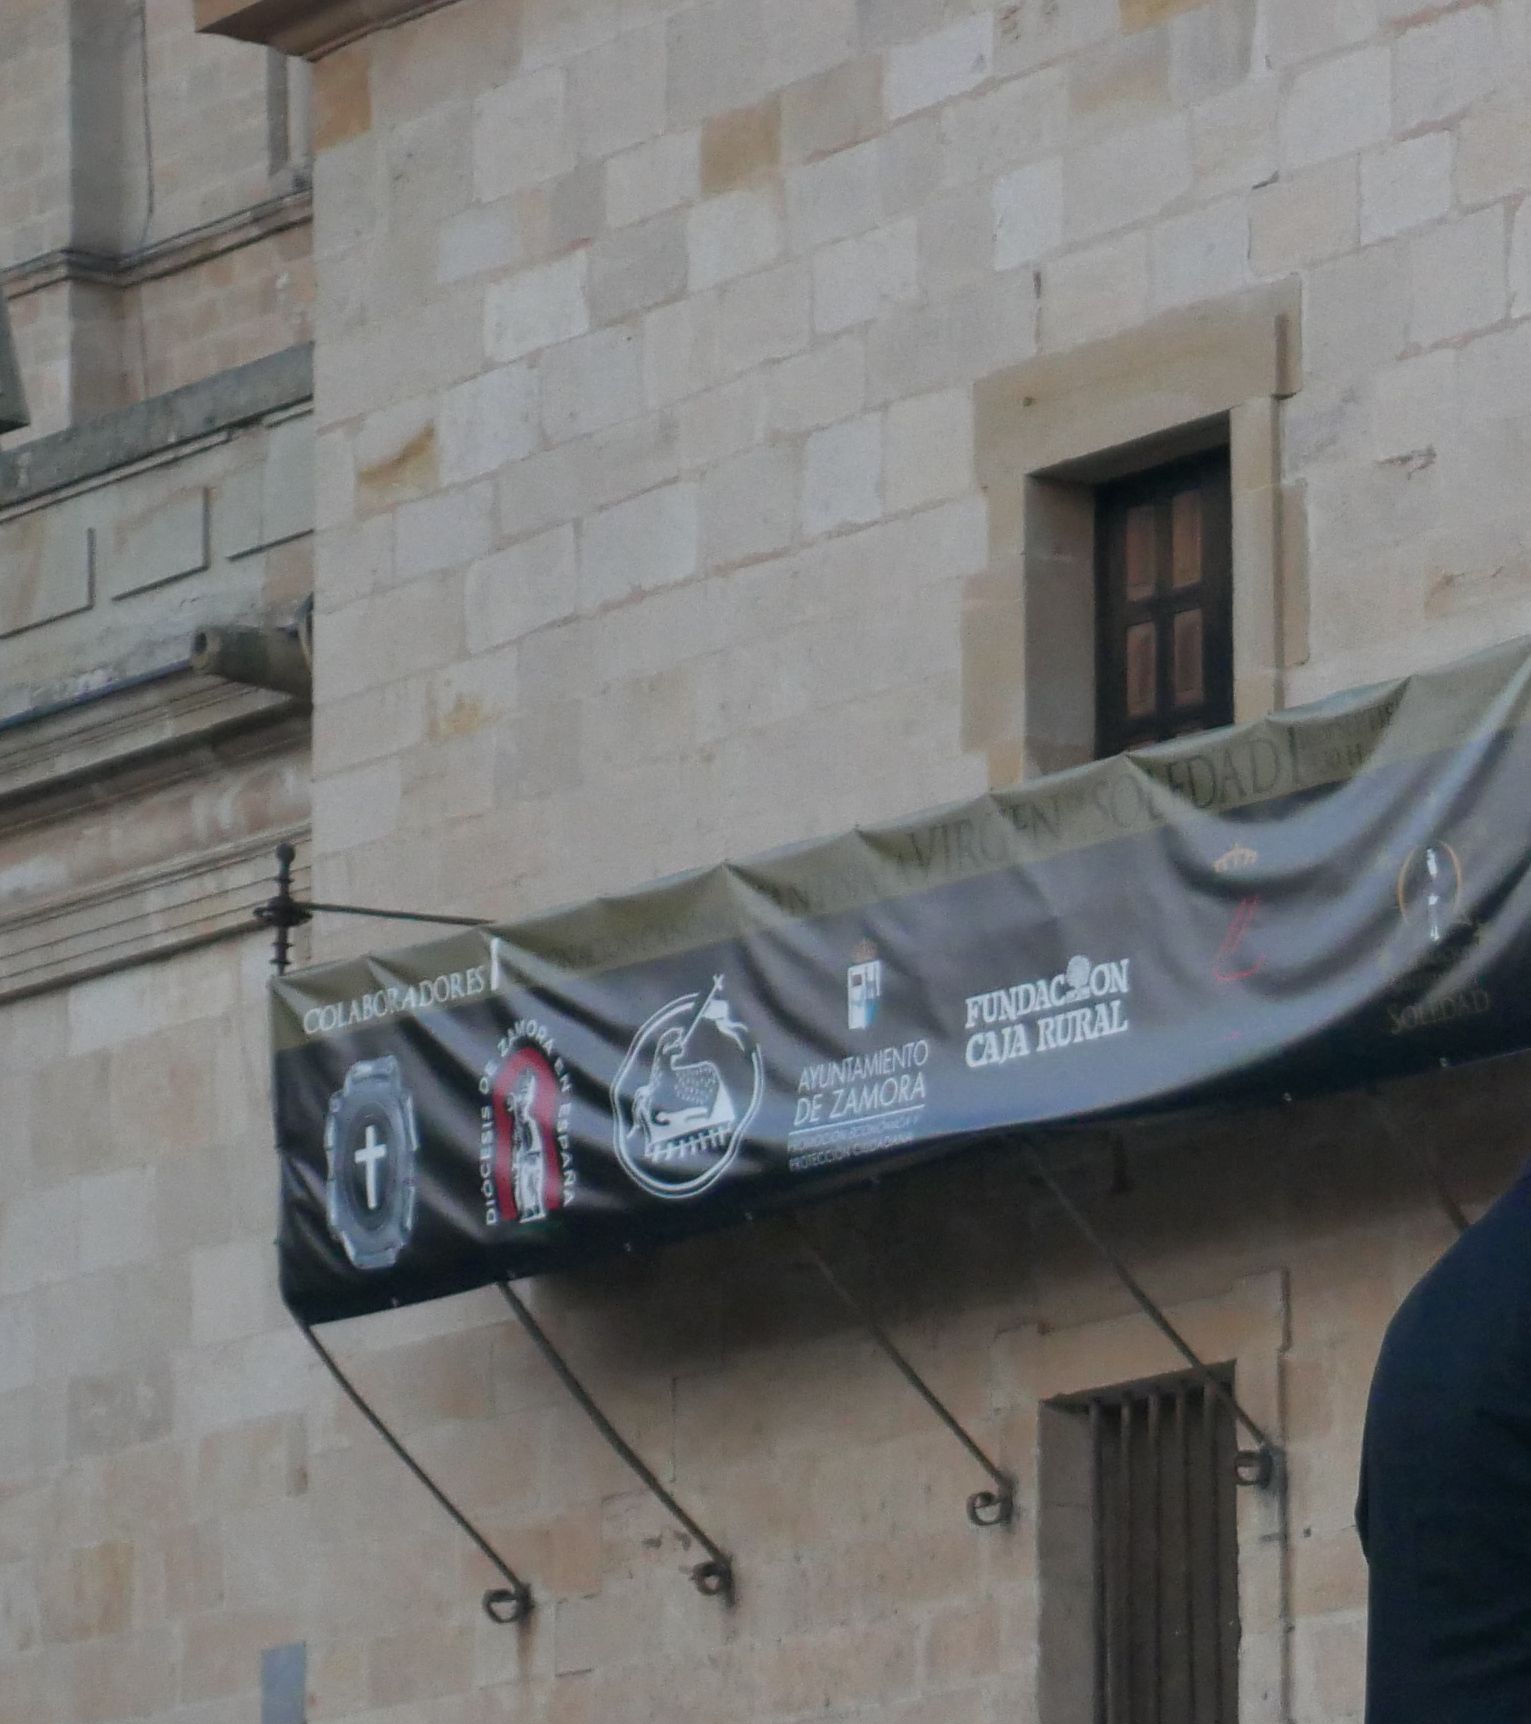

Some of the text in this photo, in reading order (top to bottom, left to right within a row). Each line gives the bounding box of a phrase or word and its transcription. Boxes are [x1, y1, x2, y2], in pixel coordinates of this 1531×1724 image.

[303, 965, 485, 1035] COLABORADORES
[497, 1019, 555, 1057] ZAMORA
[965, 1000, 1129, 1068] CAJA RURAL
[798, 1040, 929, 1093] AYUNTAMIENTO
[794, 1071, 926, 1127] DE ZAMORA
